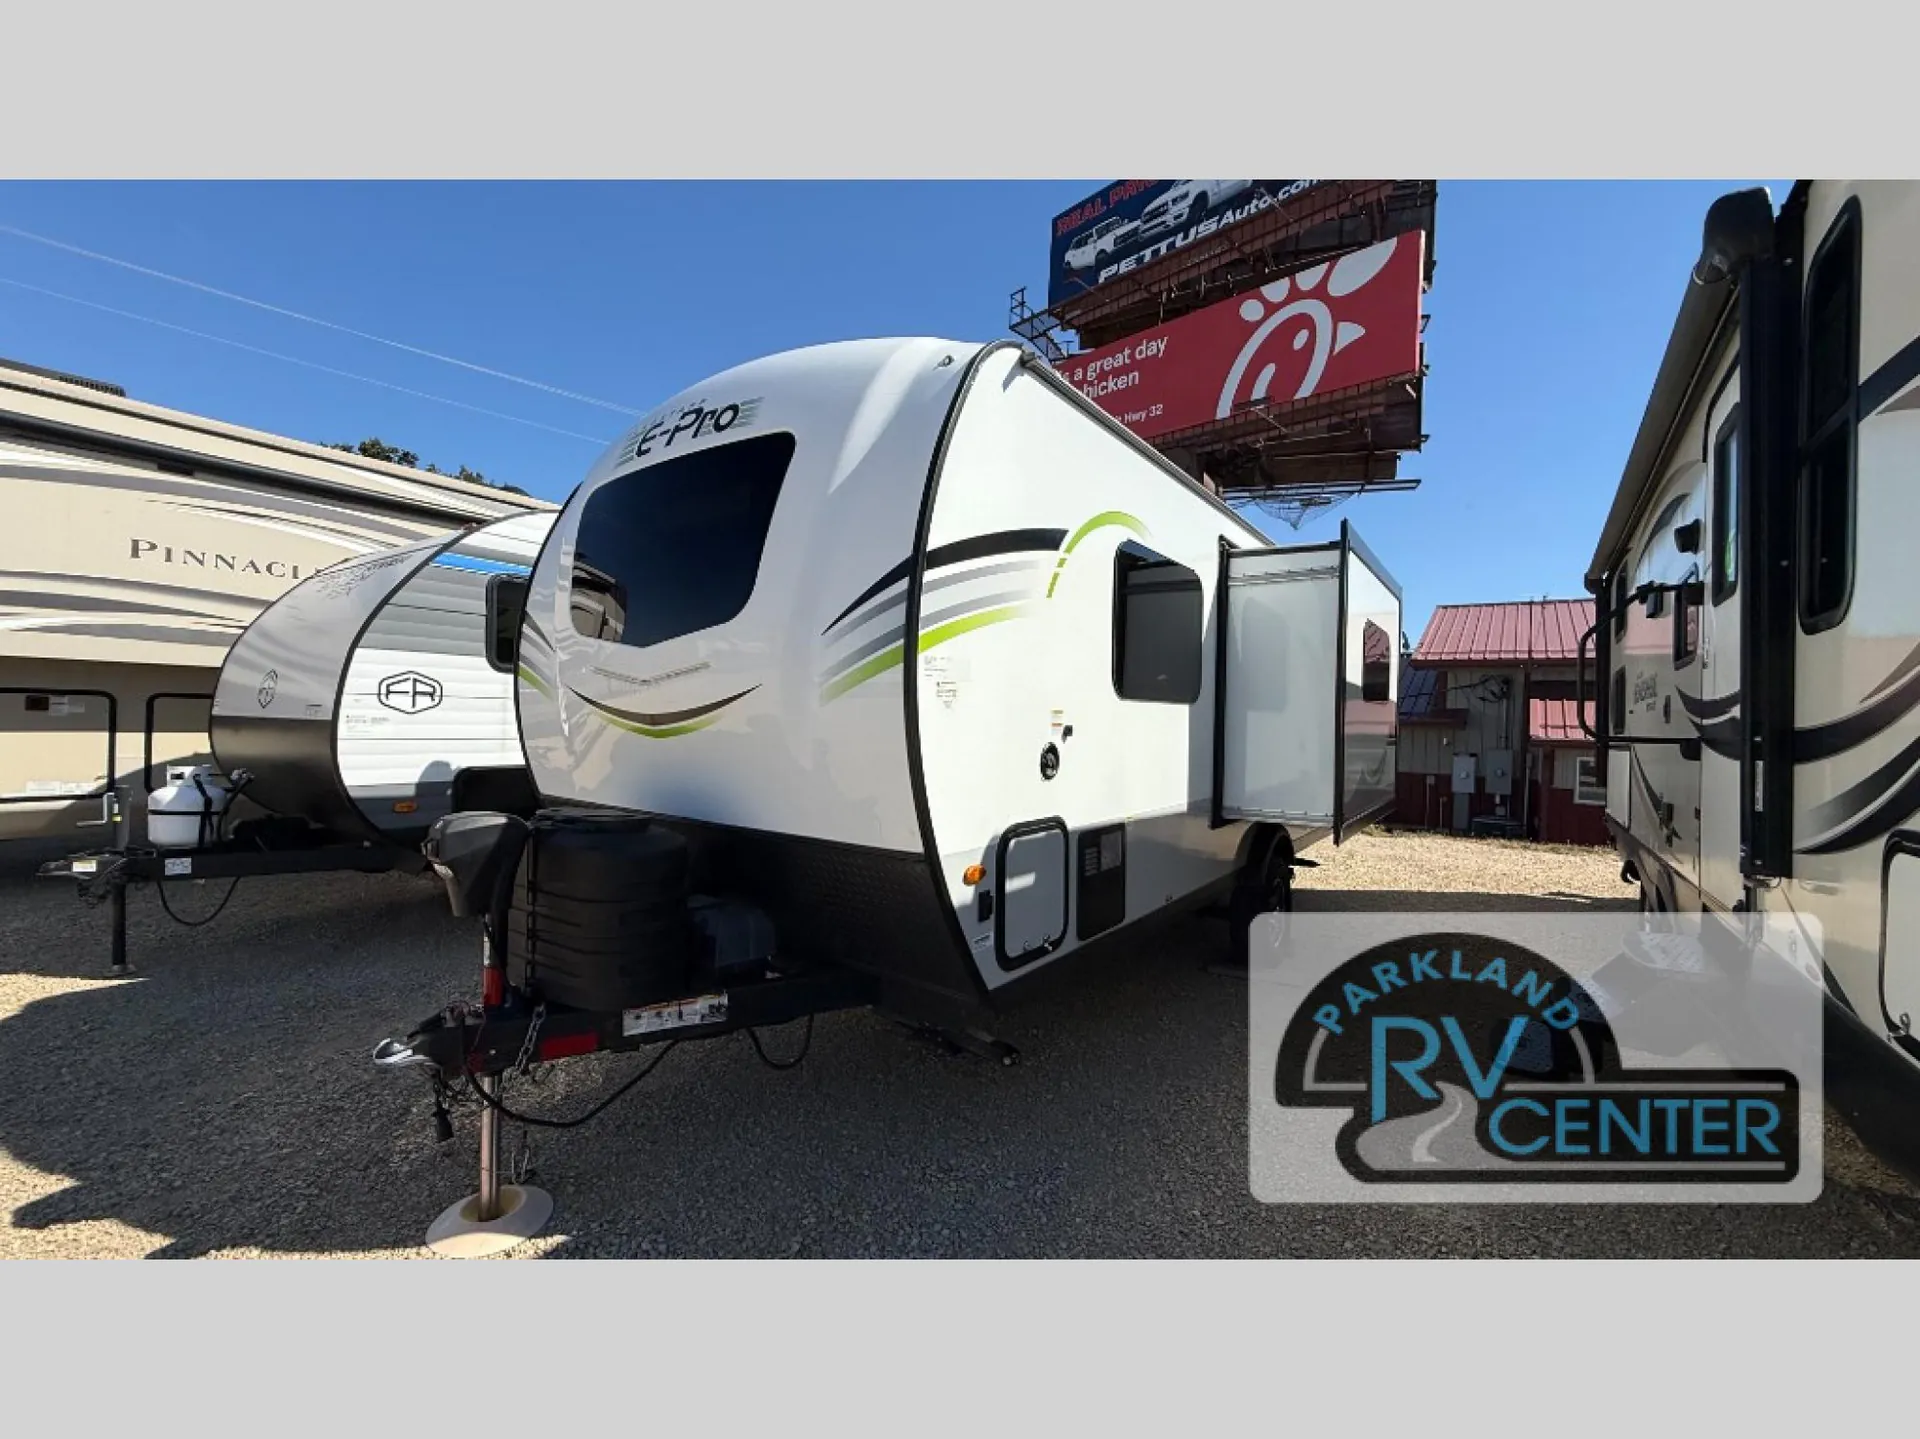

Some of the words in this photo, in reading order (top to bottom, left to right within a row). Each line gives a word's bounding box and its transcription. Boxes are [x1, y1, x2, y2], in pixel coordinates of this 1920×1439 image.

[1073, 368, 1082, 381] a
[1087, 346, 1131, 381] great
[1135, 336, 1168, 358] day
[1083, 371, 1139, 399] hicken
[636, 402, 740, 457] E-Pro
[1124, 409, 1147, 424] Hwy
[1149, 404, 1163, 417] 32
[130, 538, 302, 580] PINNACL
